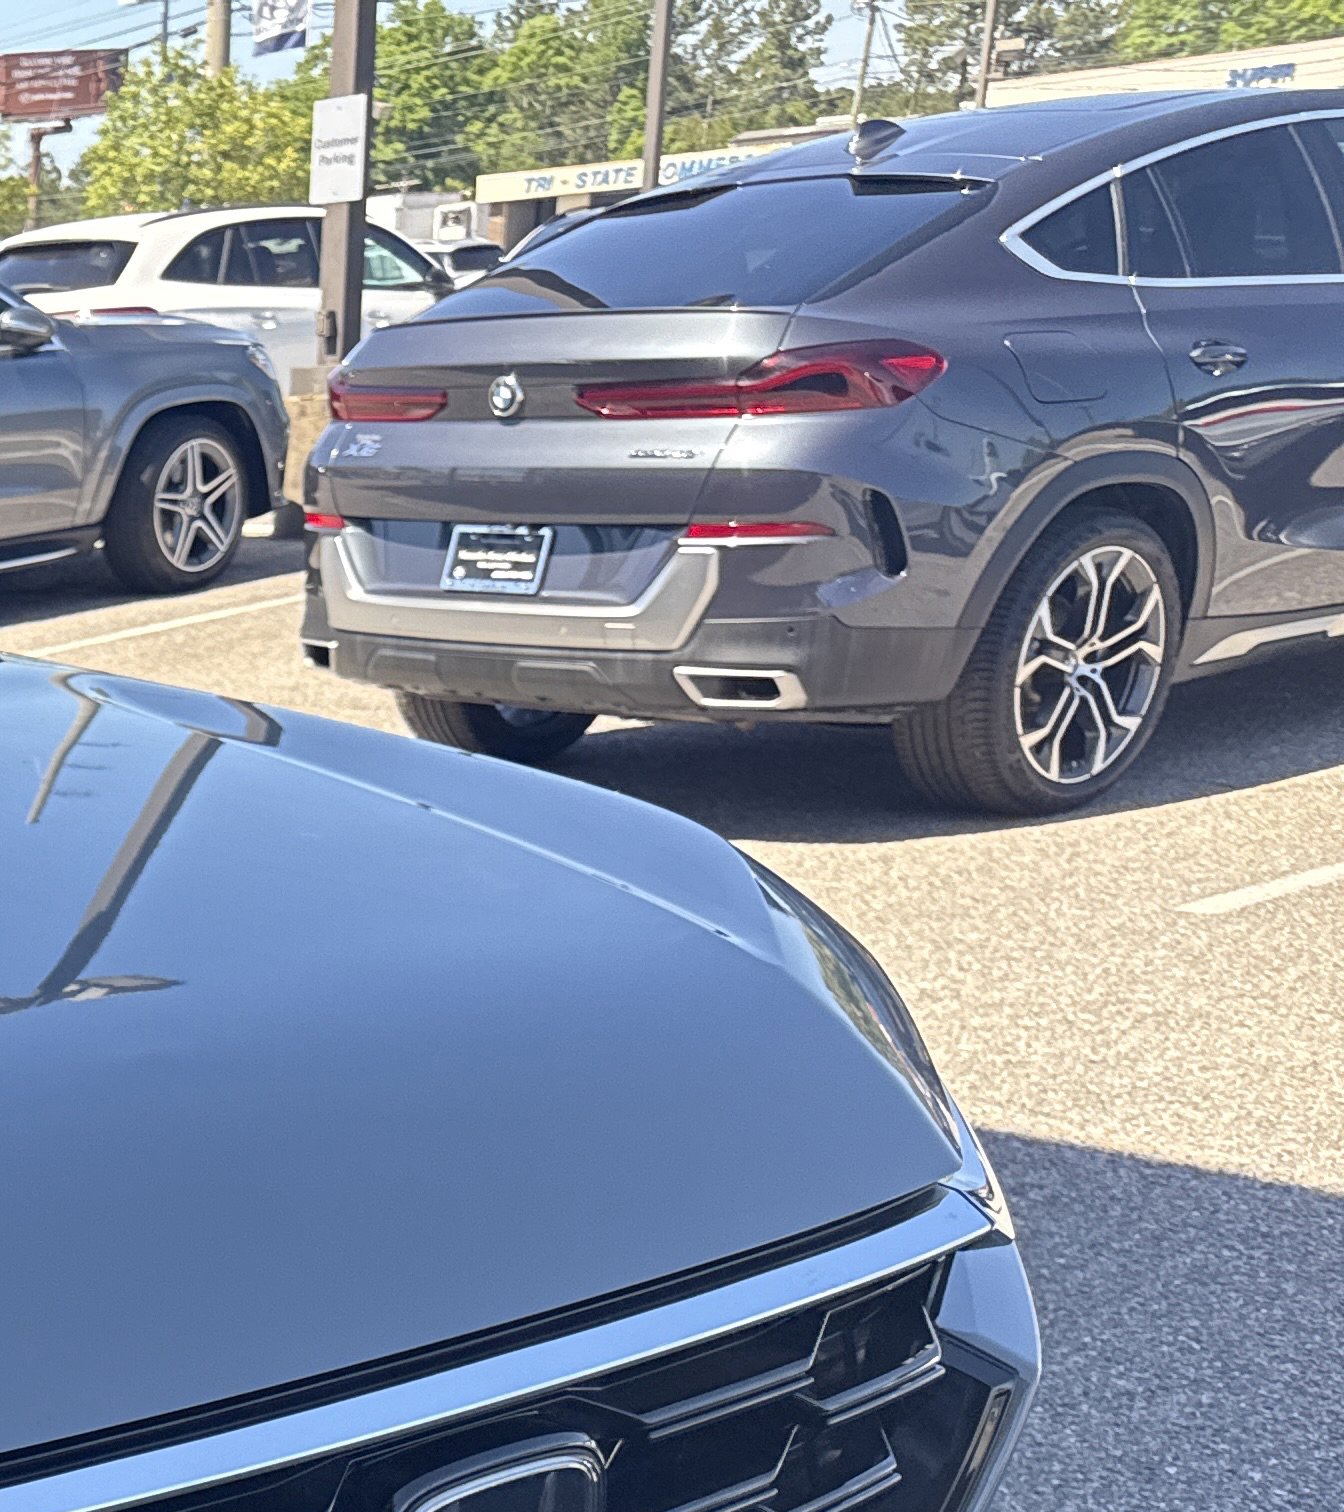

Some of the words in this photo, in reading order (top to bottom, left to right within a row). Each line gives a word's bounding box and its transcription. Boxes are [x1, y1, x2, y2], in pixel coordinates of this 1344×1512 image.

[318, 152, 355, 167] Parking
[524, 175, 554, 194] TRI
[575, 166, 638, 189] STATE
